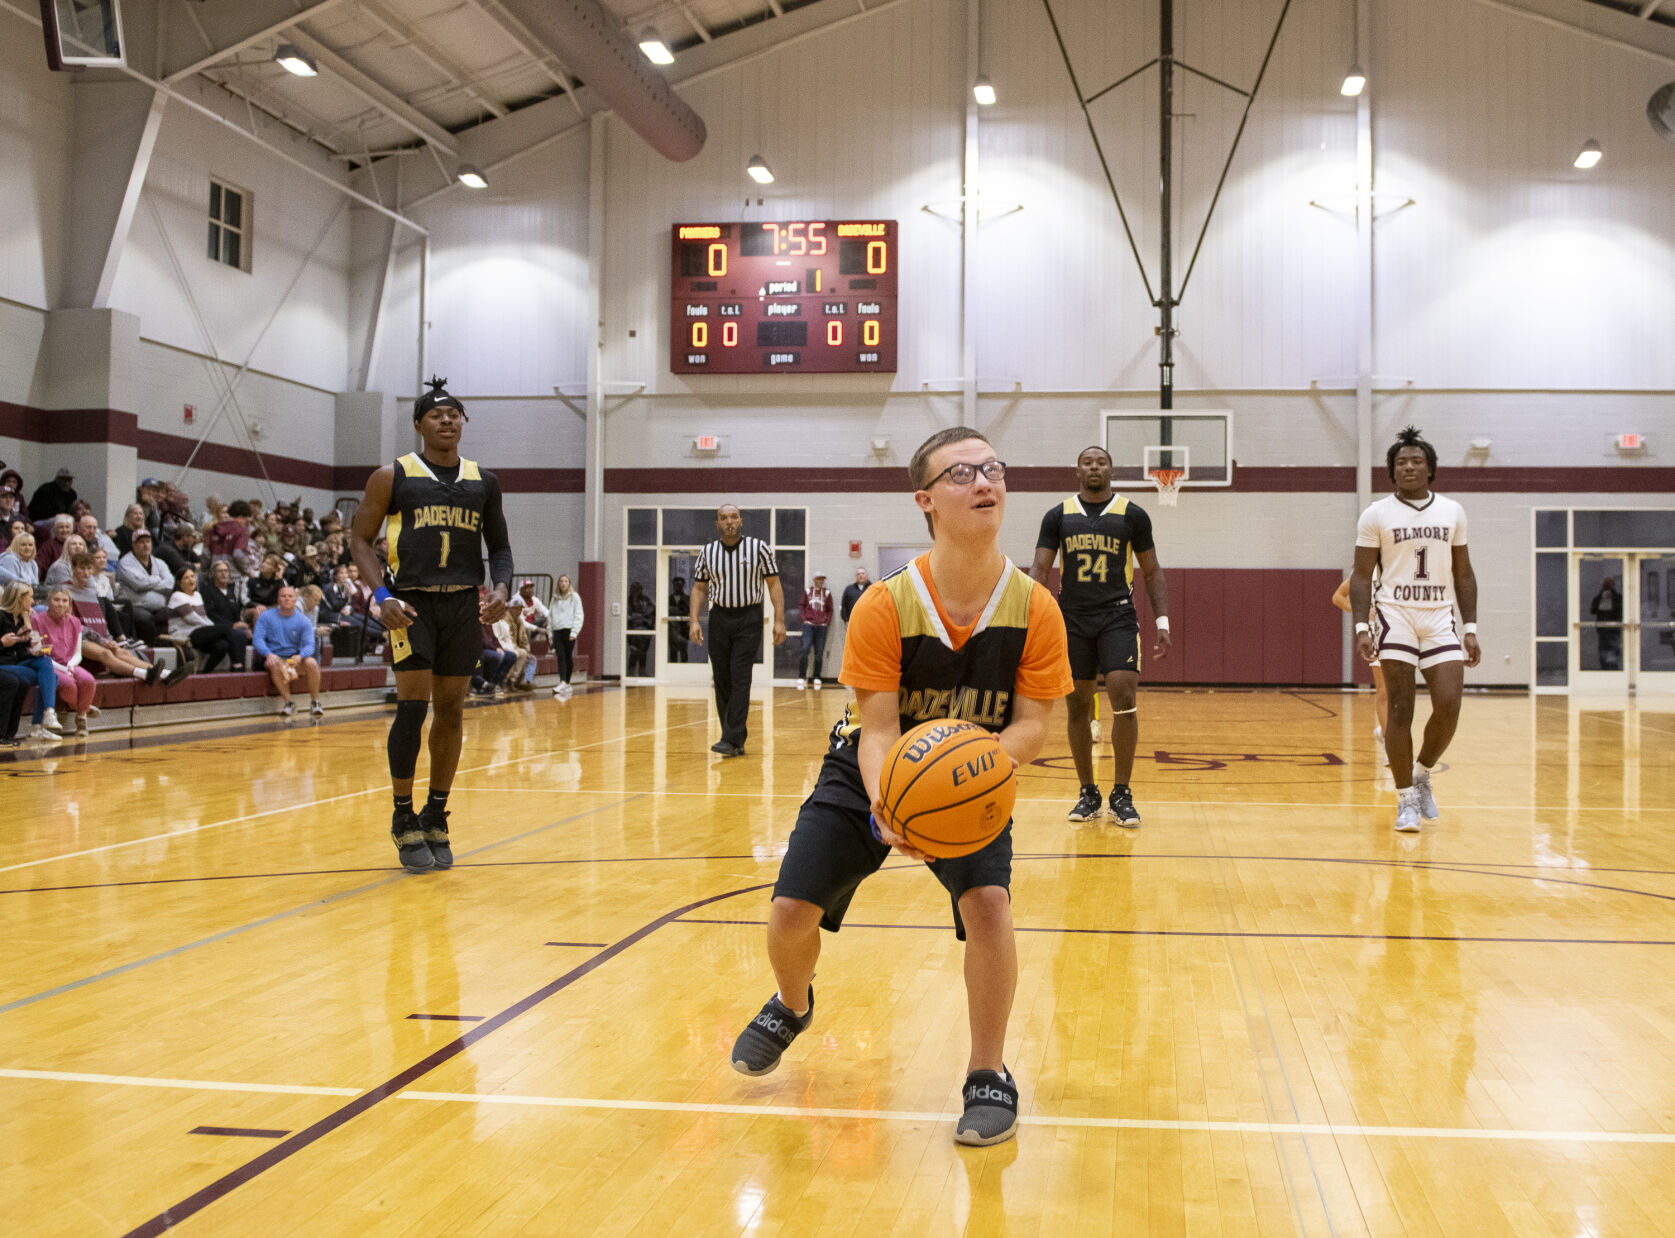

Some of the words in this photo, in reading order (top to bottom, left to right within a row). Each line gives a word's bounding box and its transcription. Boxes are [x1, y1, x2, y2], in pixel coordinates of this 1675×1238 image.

[762, 222, 827, 256] 7:55
[708, 243, 728, 276] 0
[866, 241, 887, 274] 0
[768, 280, 798, 295] period
[686, 304, 708, 316] fouls
[767, 303, 798, 316] player
[857, 302, 880, 314] fouls
[692, 321, 708, 348] 0
[722, 321, 739, 348] 0
[827, 320, 843, 346] 0
[863, 320, 880, 346] 0
[688, 354, 706, 364] won
[770, 353, 794, 365] game
[859, 353, 878, 363] won
[413, 505, 480, 532] DADEVILLE
[1065, 534, 1120, 555] DADEVILLE
[1392, 526, 1450, 545] ELMORE
[439, 531, 450, 568] 1
[1076, 553, 1109, 583] 24
[1414, 546, 1430, 581] 1
[1393, 585, 1446, 601] COUNTY
[899, 685, 1010, 726] DADEVILLE
[964, 1084, 1013, 1105] didas
